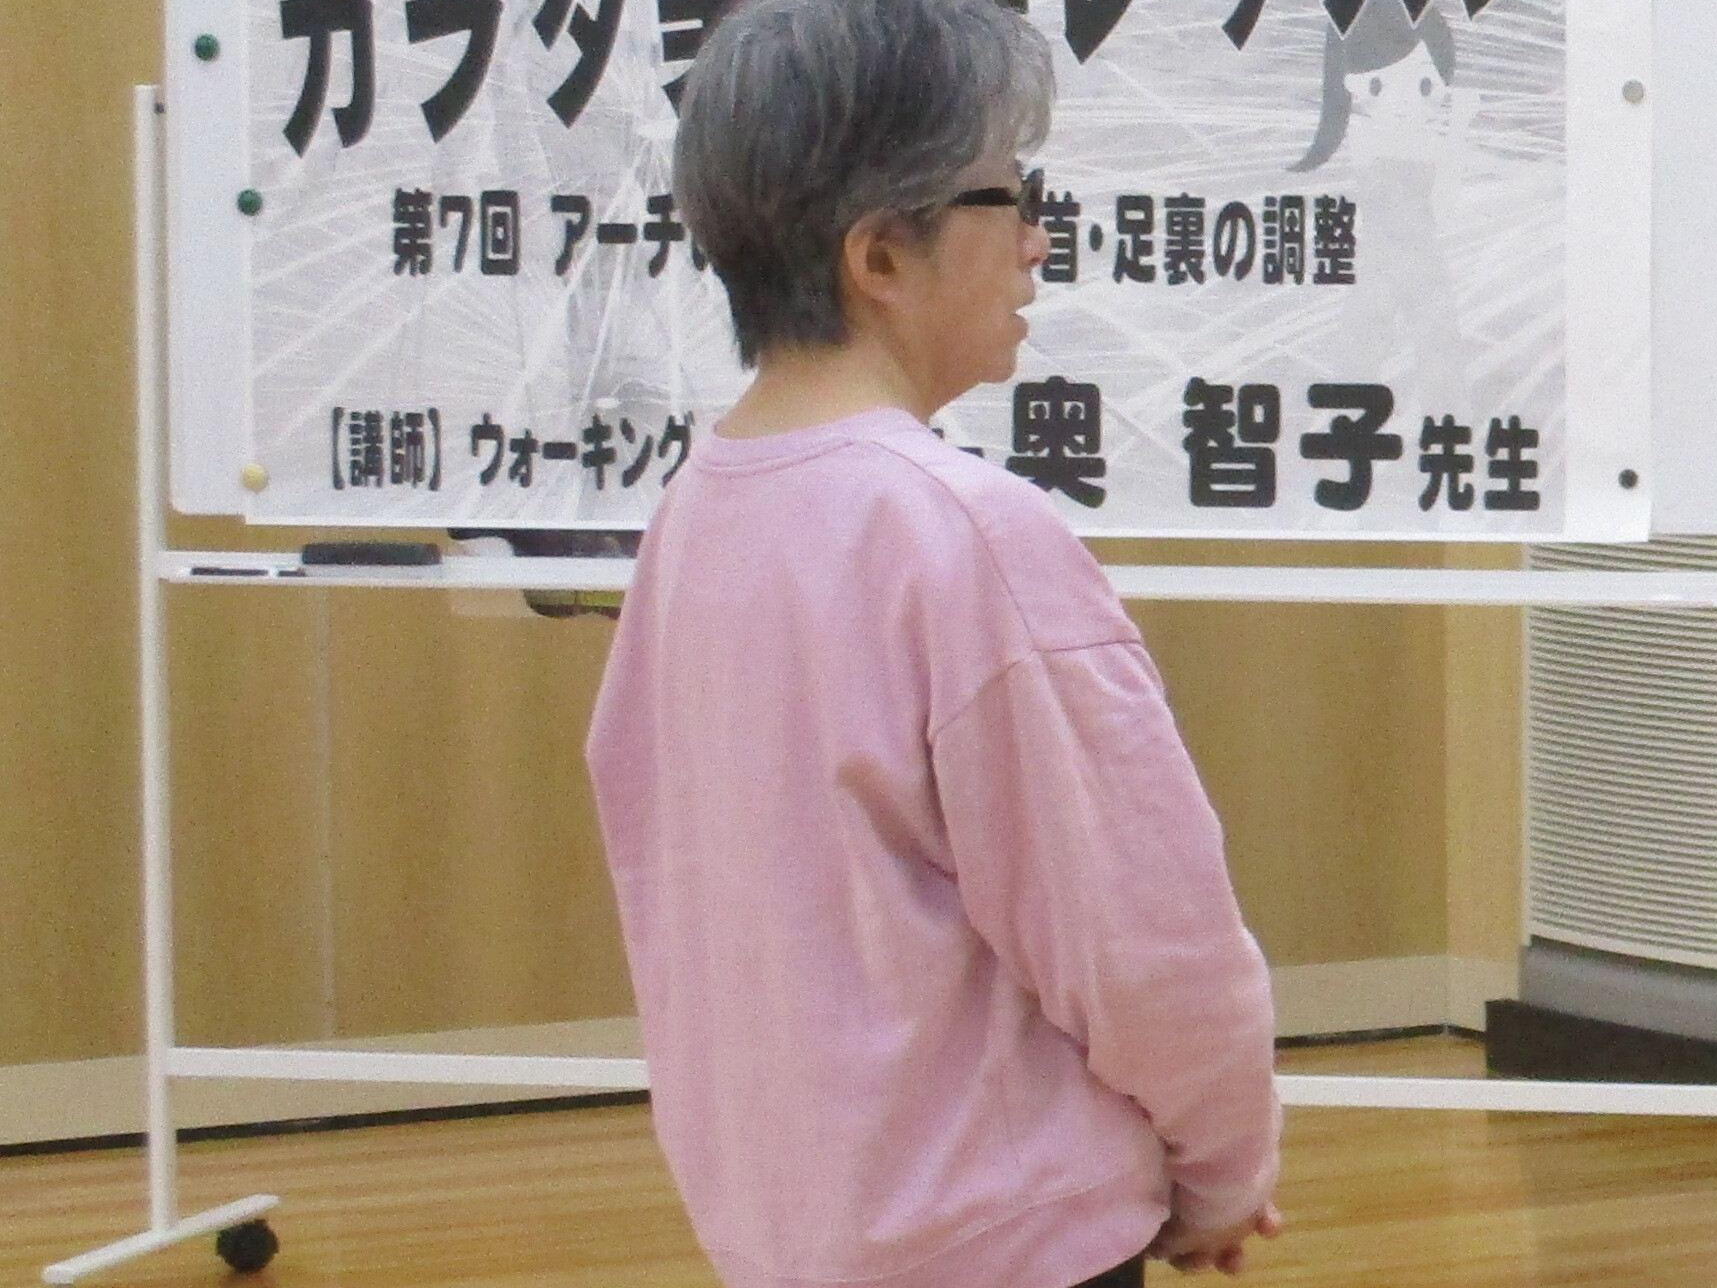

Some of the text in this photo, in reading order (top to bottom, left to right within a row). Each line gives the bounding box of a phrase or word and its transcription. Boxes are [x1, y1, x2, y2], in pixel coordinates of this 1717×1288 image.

[392, 188, 521, 277] 第7回
[549, 192, 705, 279] アーチ
[1005, 376, 1107, 509] 奥
